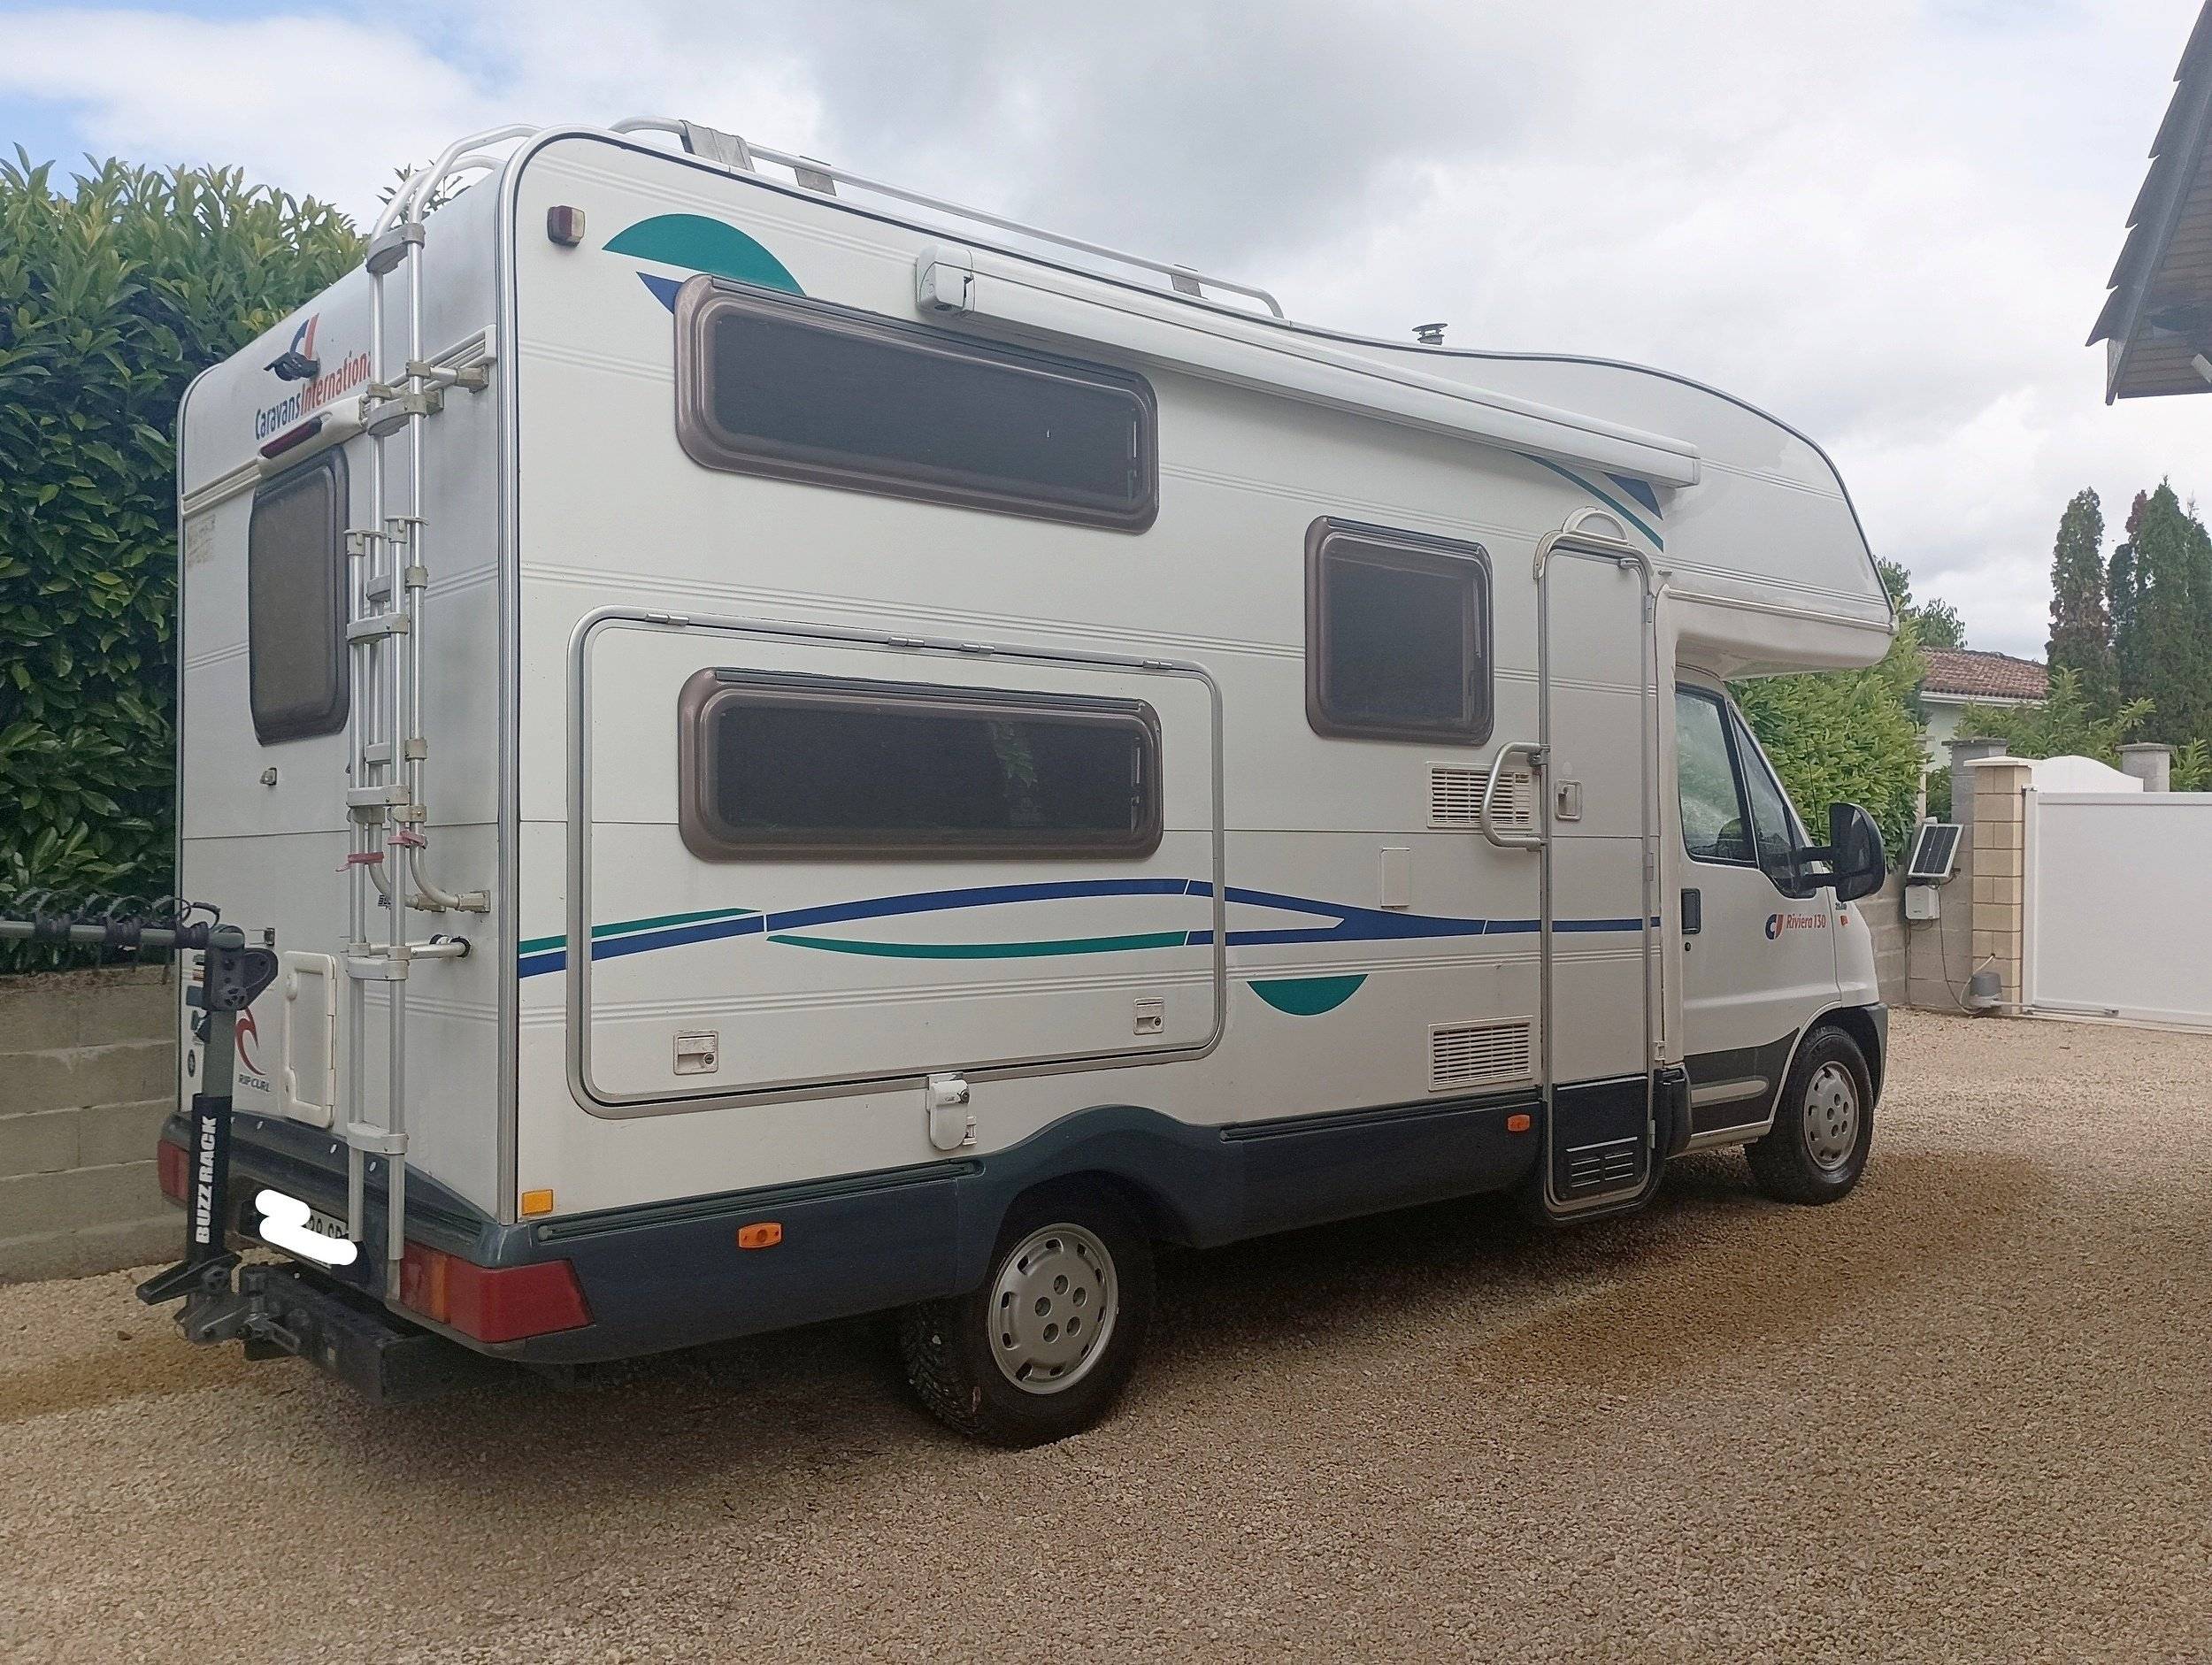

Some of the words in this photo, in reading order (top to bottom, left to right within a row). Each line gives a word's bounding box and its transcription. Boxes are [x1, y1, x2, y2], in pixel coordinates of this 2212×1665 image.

[1786, 913, 1812, 929] Riviera
[1814, 914, 1826, 928] 130
[251, 1078, 271, 1093] CURL
